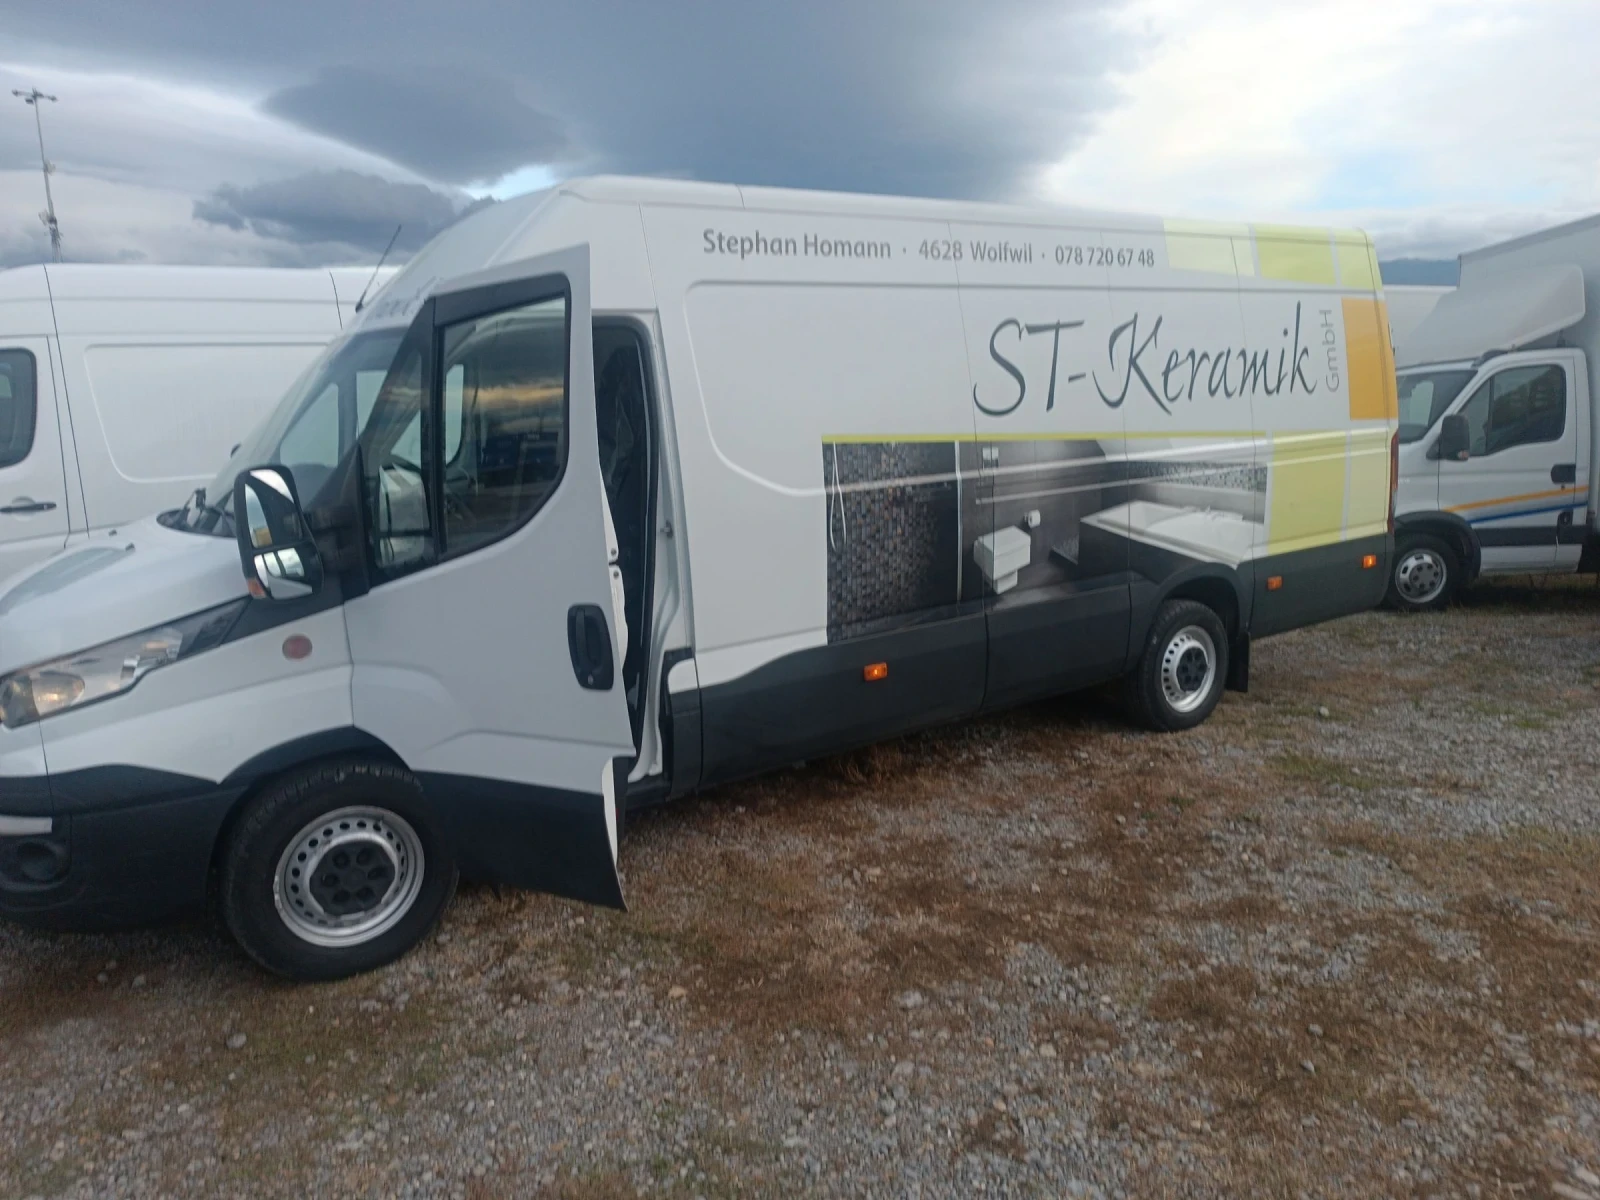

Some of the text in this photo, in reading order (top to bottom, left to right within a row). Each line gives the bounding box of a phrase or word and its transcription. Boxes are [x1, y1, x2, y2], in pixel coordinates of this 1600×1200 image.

[703, 228, 797, 260] Stephan
[803, 233, 892, 259] Homann
[918, 239, 963, 261] 4628
[970, 240, 1033, 264] Wolfwil
[1055, 245, 1083, 266] 078
[1088, 246, 1114, 267] 720
[973, 300, 1318, 417] ST-Keramik
[1319, 308, 1340, 393] GmbH
